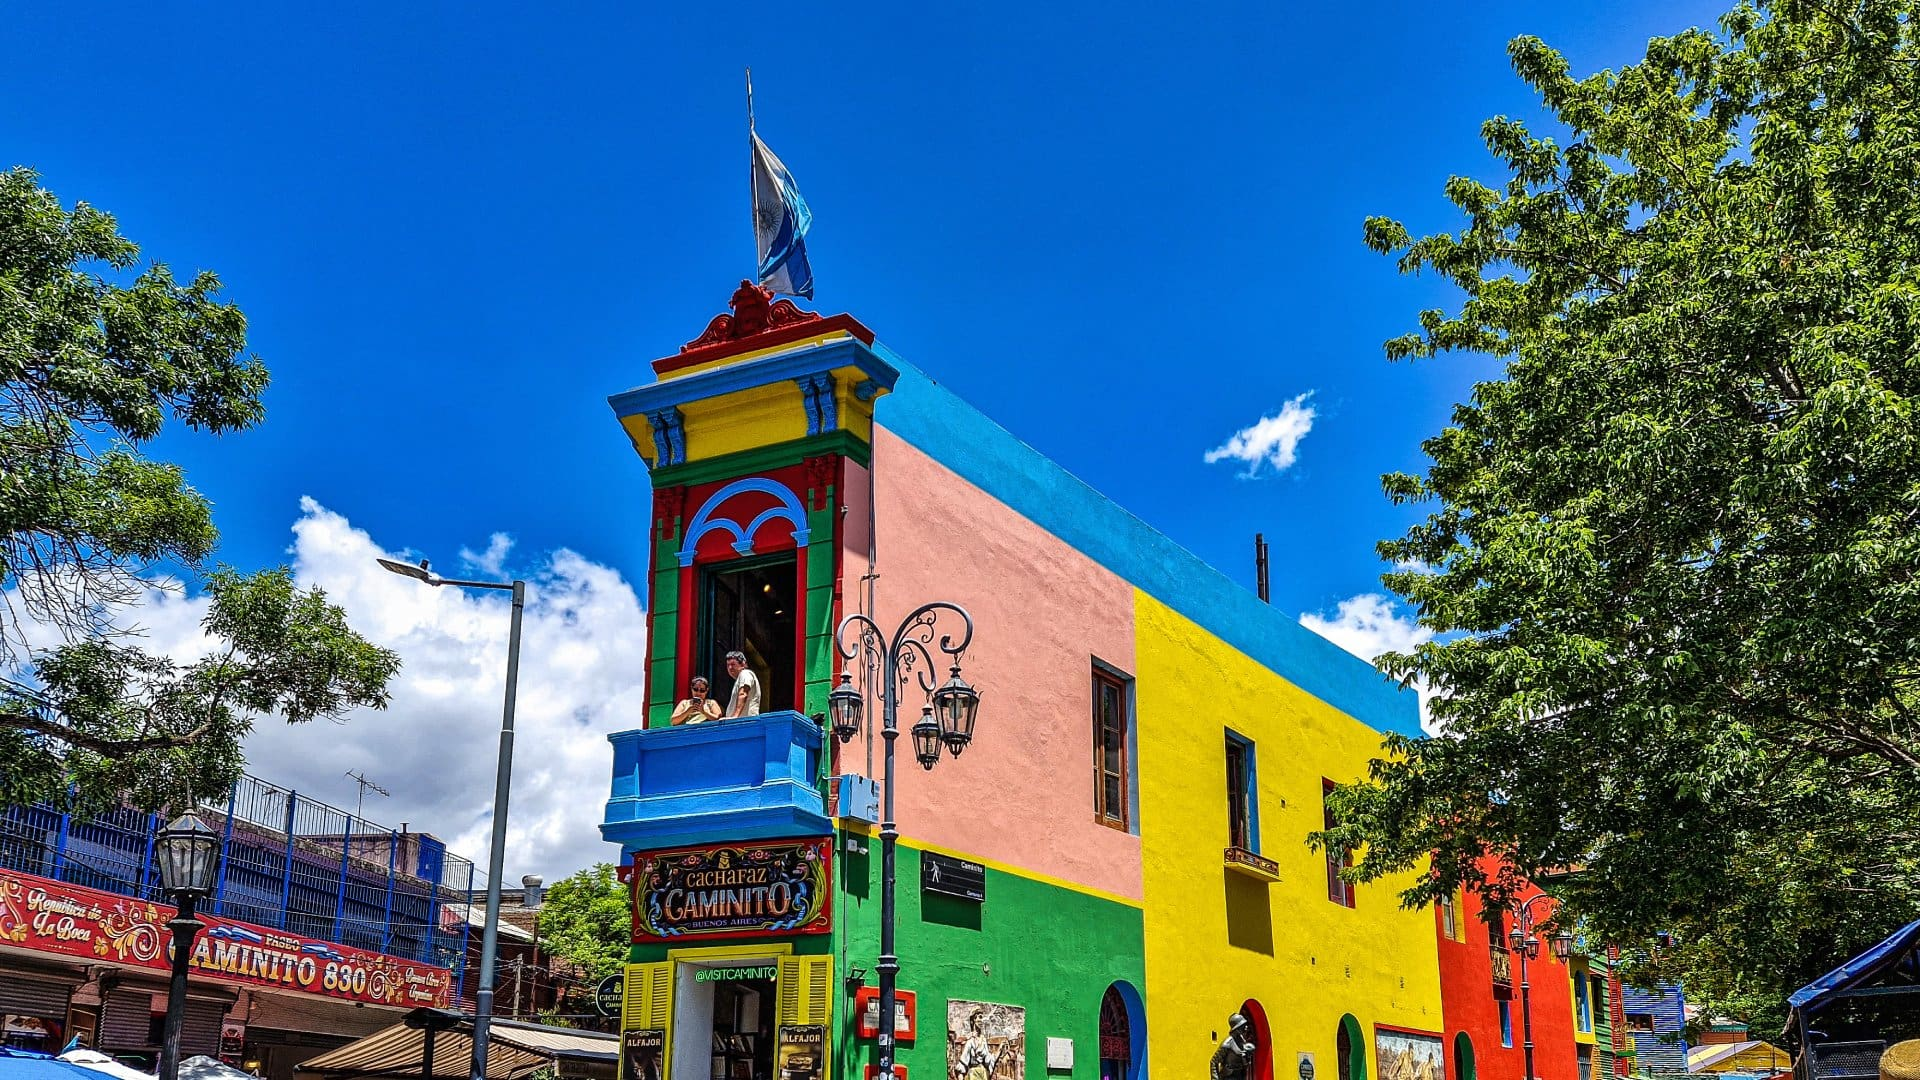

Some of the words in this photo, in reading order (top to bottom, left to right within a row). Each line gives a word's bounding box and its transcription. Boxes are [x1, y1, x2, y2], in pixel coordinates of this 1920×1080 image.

[665, 881, 792, 922] CAMINITO
[33, 911, 56, 937] La
[56, 916, 91, 942] Boca
[692, 919, 728, 929] BUENOS
[730, 917, 758, 926] AIRES
[264, 933, 300, 952] PASEO
[322, 961, 367, 994] 830
[695, 966, 778, 983] @VISITCAMINITO
[627, 1038, 661, 1047] ALFAJOR
[782, 1032, 821, 1043] ALFAJOR
